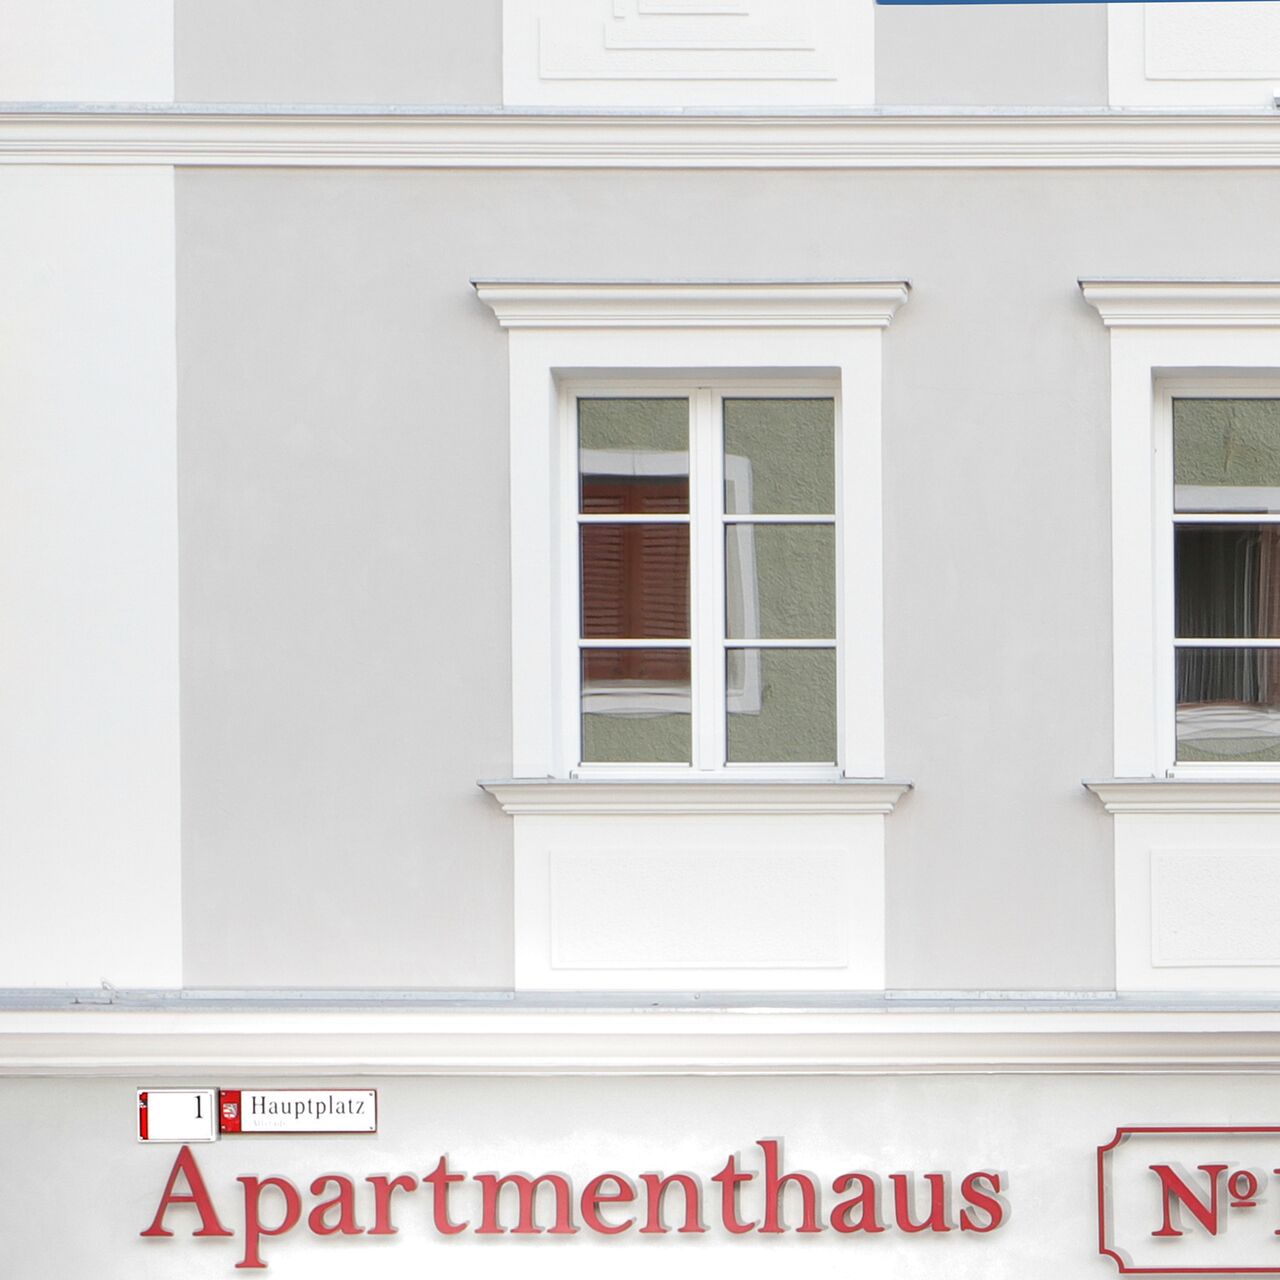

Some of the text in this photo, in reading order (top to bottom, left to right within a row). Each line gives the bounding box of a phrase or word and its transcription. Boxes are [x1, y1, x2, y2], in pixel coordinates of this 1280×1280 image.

[194, 1095, 203, 1119] 1
[251, 1095, 365, 1120] Hauptplatz
[139, 1140, 1004, 1269] Apartmenthaus
